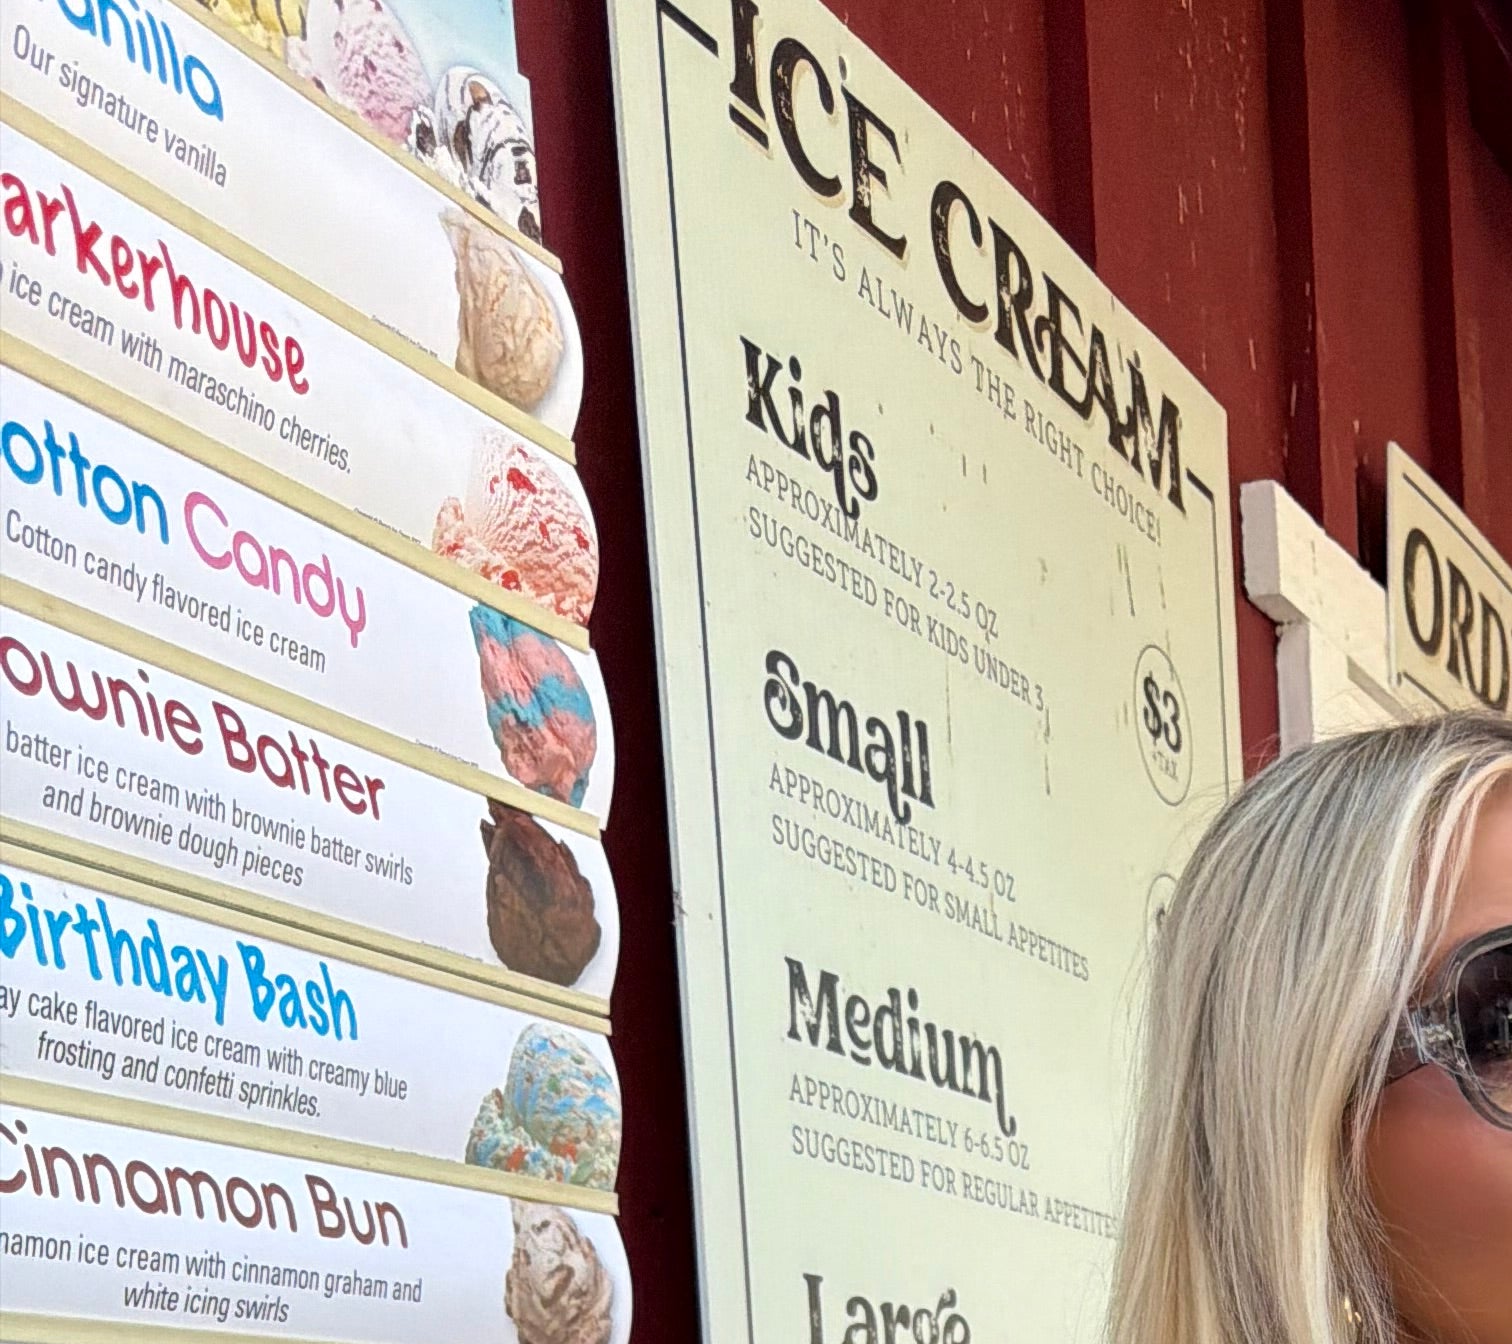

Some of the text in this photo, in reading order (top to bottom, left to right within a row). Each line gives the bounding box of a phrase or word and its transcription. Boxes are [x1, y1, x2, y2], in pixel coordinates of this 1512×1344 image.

[14, 24, 228, 188] Our signature vanilla
[43, 0, 223, 121] anilla
[729, 0, 1186, 513] ICE CREAM
[10, 262, 351, 474] ice cream with maraschino cherries.
[740, 335, 878, 519] Kids
[792, 209, 1161, 547] IT'S ALWAYS THE RIGHT CHOICE!
[6, 508, 326, 673] Cotton candy flavored ice cream
[183, 492, 367, 648] Candy
[746, 454, 1000, 641] APPROXIMATELY 2-2.5 OZ
[749, 506, 1044, 710] SUGGESTED FOR KIDS UNDER 3
[212, 699, 386, 821] Batter
[764, 648, 935, 825] Small
[1142, 671, 1182, 756] $3
[42, 780, 305, 888] and brownie dough pieces
[769, 762, 1016, 903] APPROXIMATELY 4-4.5 OZ
[771, 814, 1089, 982] SUGGESTED FOR SMALL APPETITES
[237, 941, 358, 1041] Bash
[784, 955, 1016, 1138] Medium
[37, 1030, 321, 1118] frosting and confetti sprinkles.
[789, 1073, 1030, 1171] APPROXIMATELY 6-6.5 OZ
[305, 1174, 409, 1249] Bun
[791, 1125, 914, 1183] SUGGESTED
[921, 1160, 957, 1195] FOR
[962, 1172, 1039, 1217] REGULAR
[123, 1283, 289, 1323] white icing swirls
